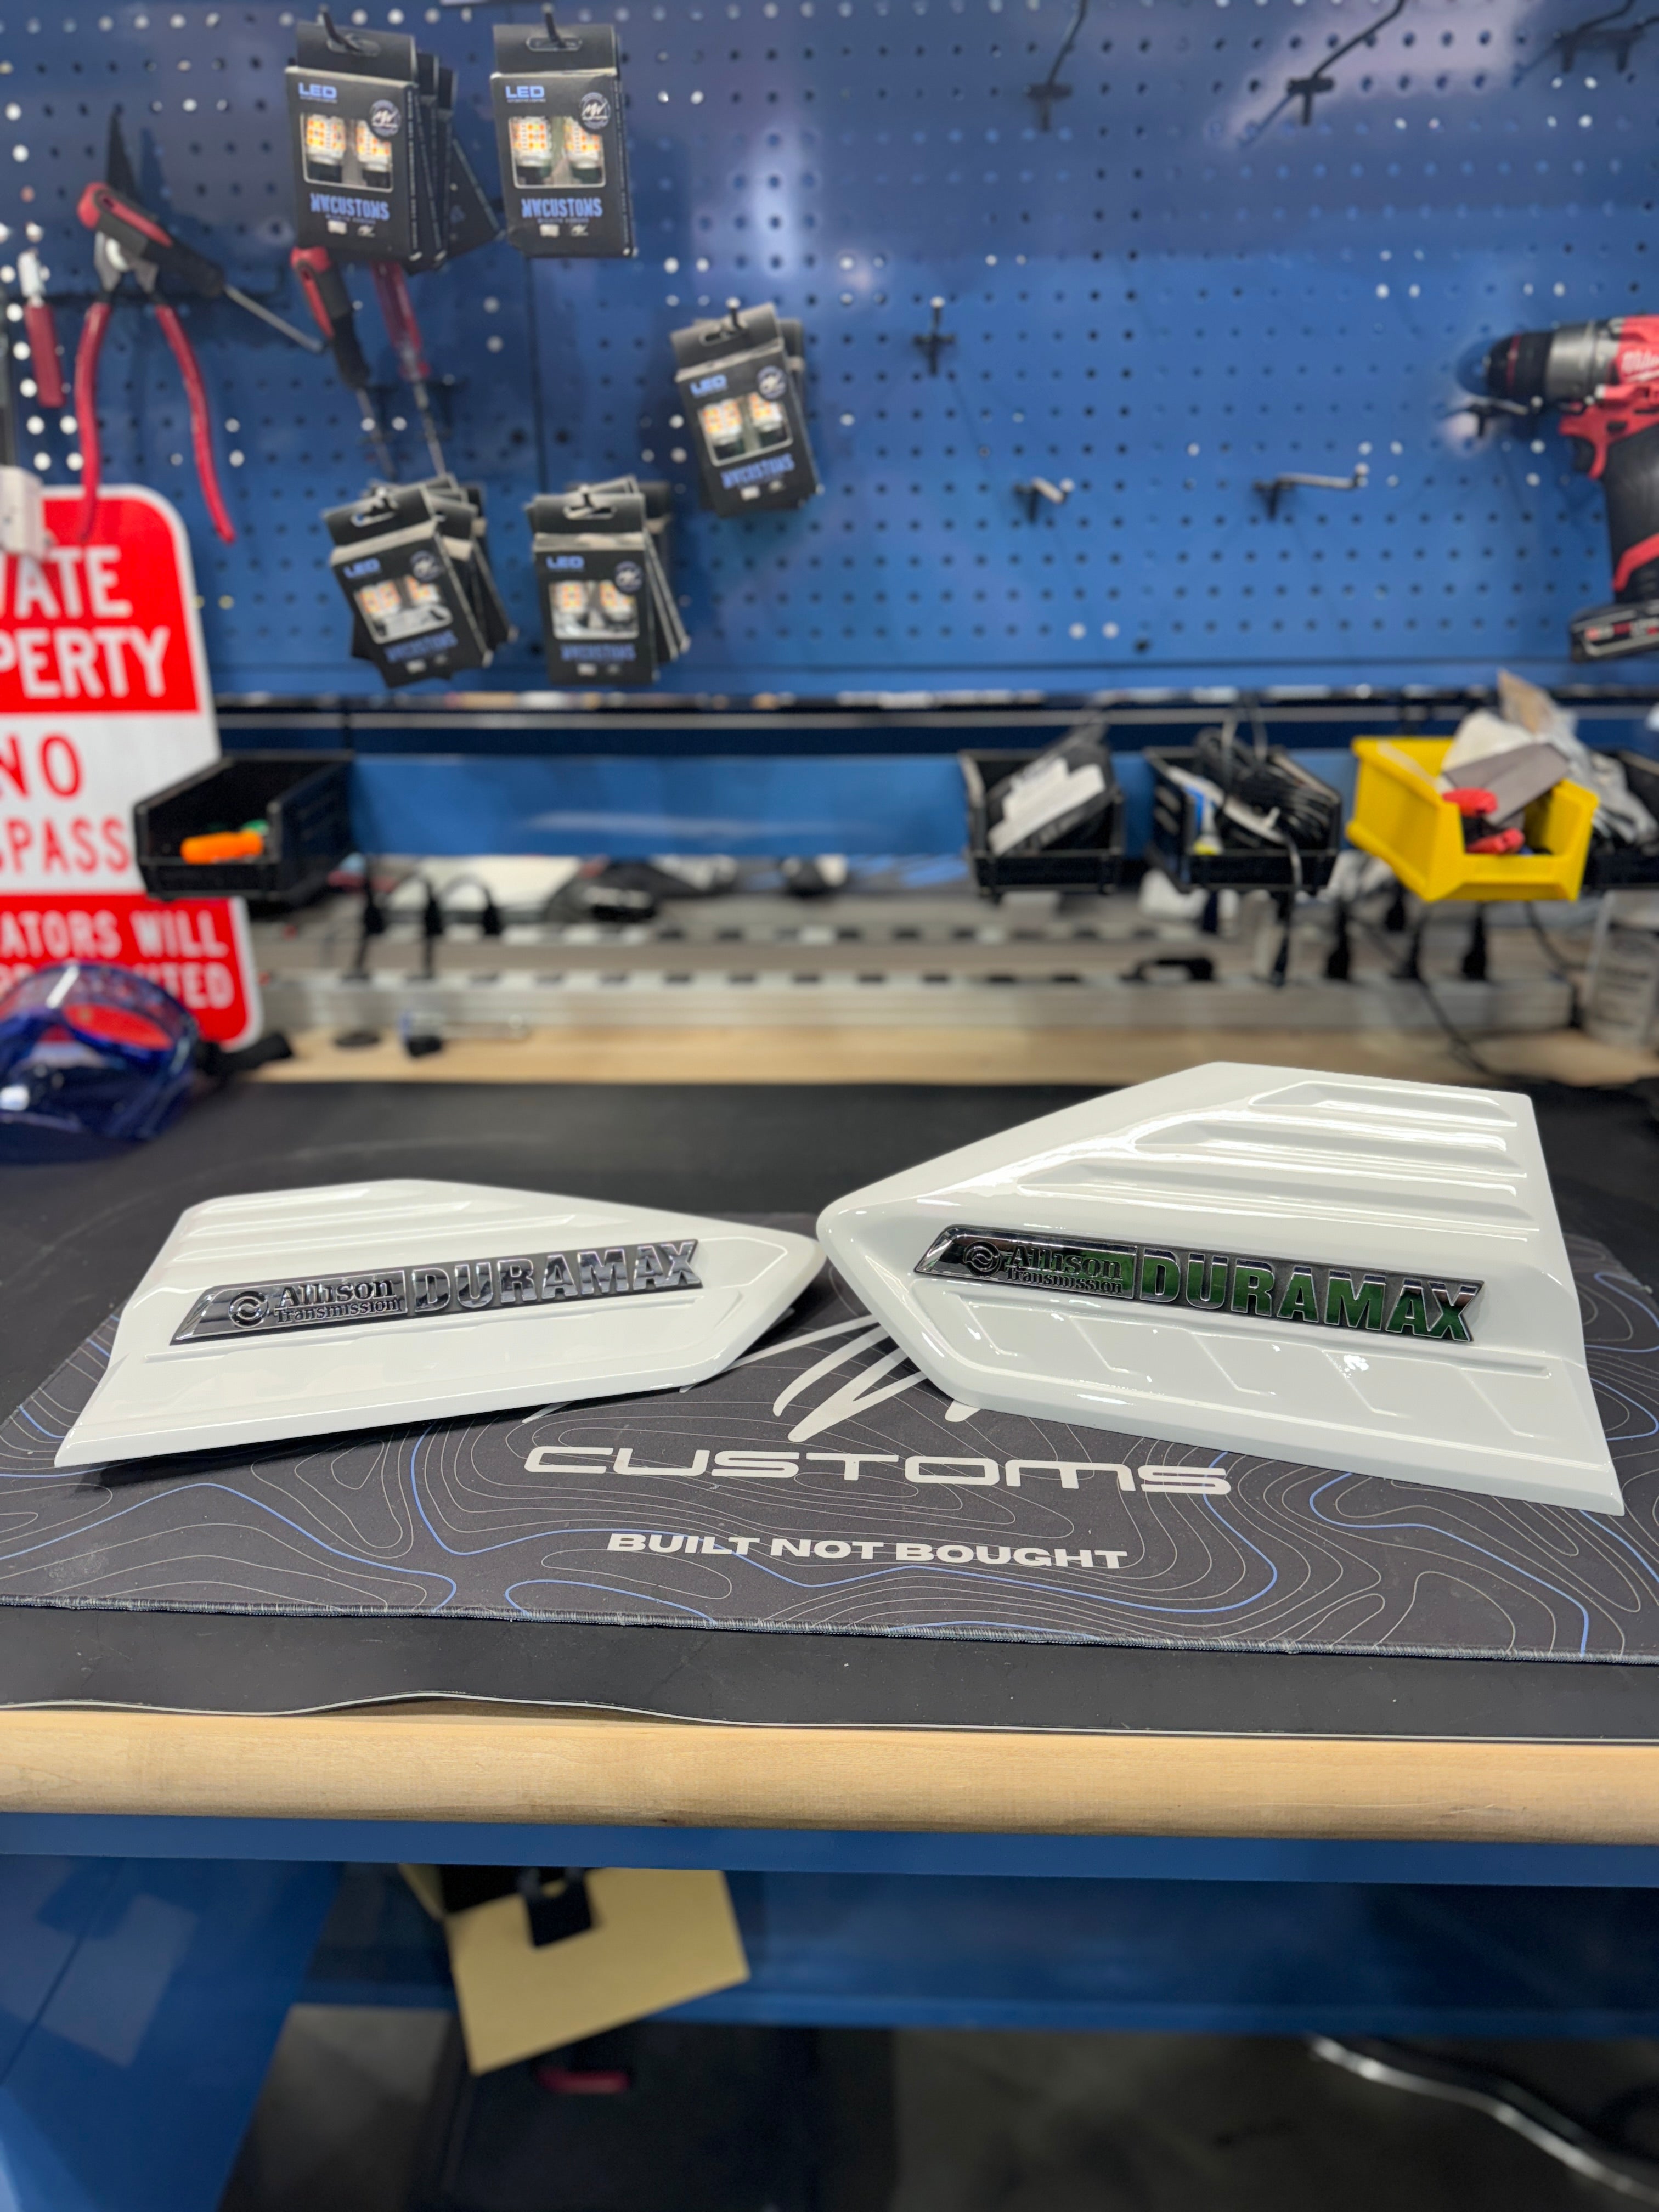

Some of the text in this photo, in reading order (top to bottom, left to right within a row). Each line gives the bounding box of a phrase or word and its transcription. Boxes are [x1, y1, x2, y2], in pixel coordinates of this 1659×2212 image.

[298, 82, 337, 100] LED
[506, 85, 545, 99] LED
[690, 374, 727, 396] LED
[343, 557, 381, 579] LED
[546, 555, 585, 570] LED
[0, 545, 133, 620] ATE
[0, 816, 132, 874] PASS
[129, 909, 229, 958] WILL
[274, 1240, 701, 1313] Allison DURAMAX
[1006, 1264, 1125, 1294] Transmission
[1006, 1245, 1480, 1342] Allison DURAMAX
[275, 1297, 400, 1324] Transmission
[524, 1446, 1232, 1496] CUSTOMS
[606, 1533, 1128, 1570] BUILT NOT BOUGHT
